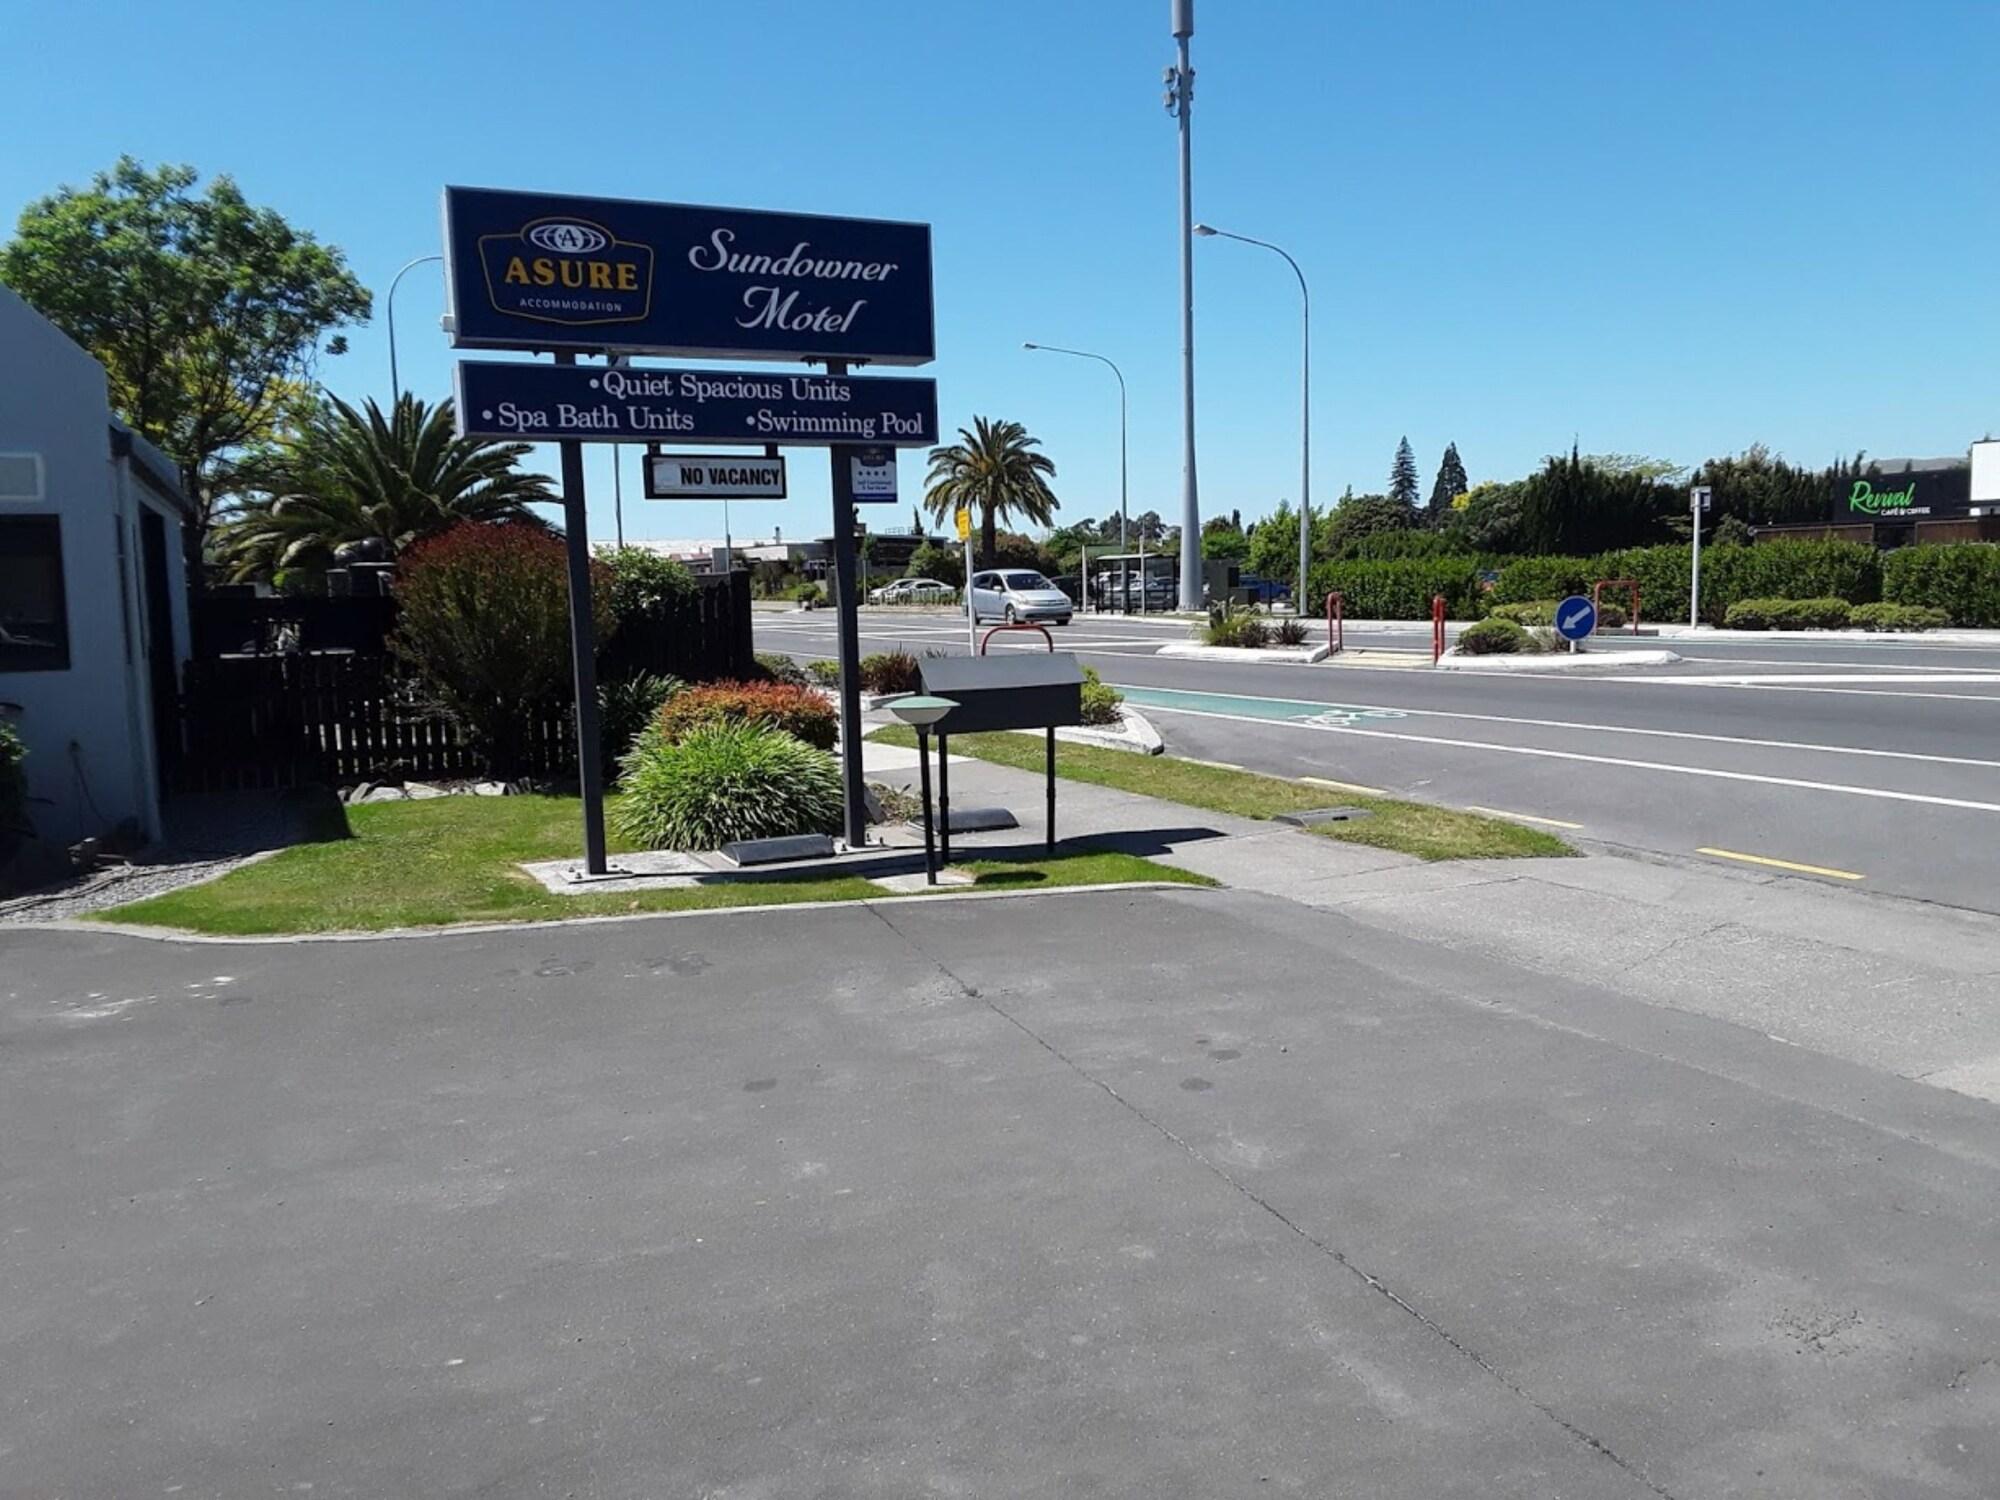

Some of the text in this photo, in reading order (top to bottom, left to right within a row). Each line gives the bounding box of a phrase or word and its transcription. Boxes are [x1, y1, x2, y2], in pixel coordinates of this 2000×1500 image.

[688, 228, 899, 281] Sundowner
[504, 256, 639, 291] ASURE
[519, 298, 622, 312] ACCOMMODATION
[735, 286, 868, 332] Motel
[603, 371, 851, 402] Quiet Spacious Units
[498, 402, 695, 432] Spa Bath Units
[757, 409, 924, 438] Swimming Pool
[680, 467, 780, 486] NO VACANCY
[1849, 480, 1916, 514] Revival
